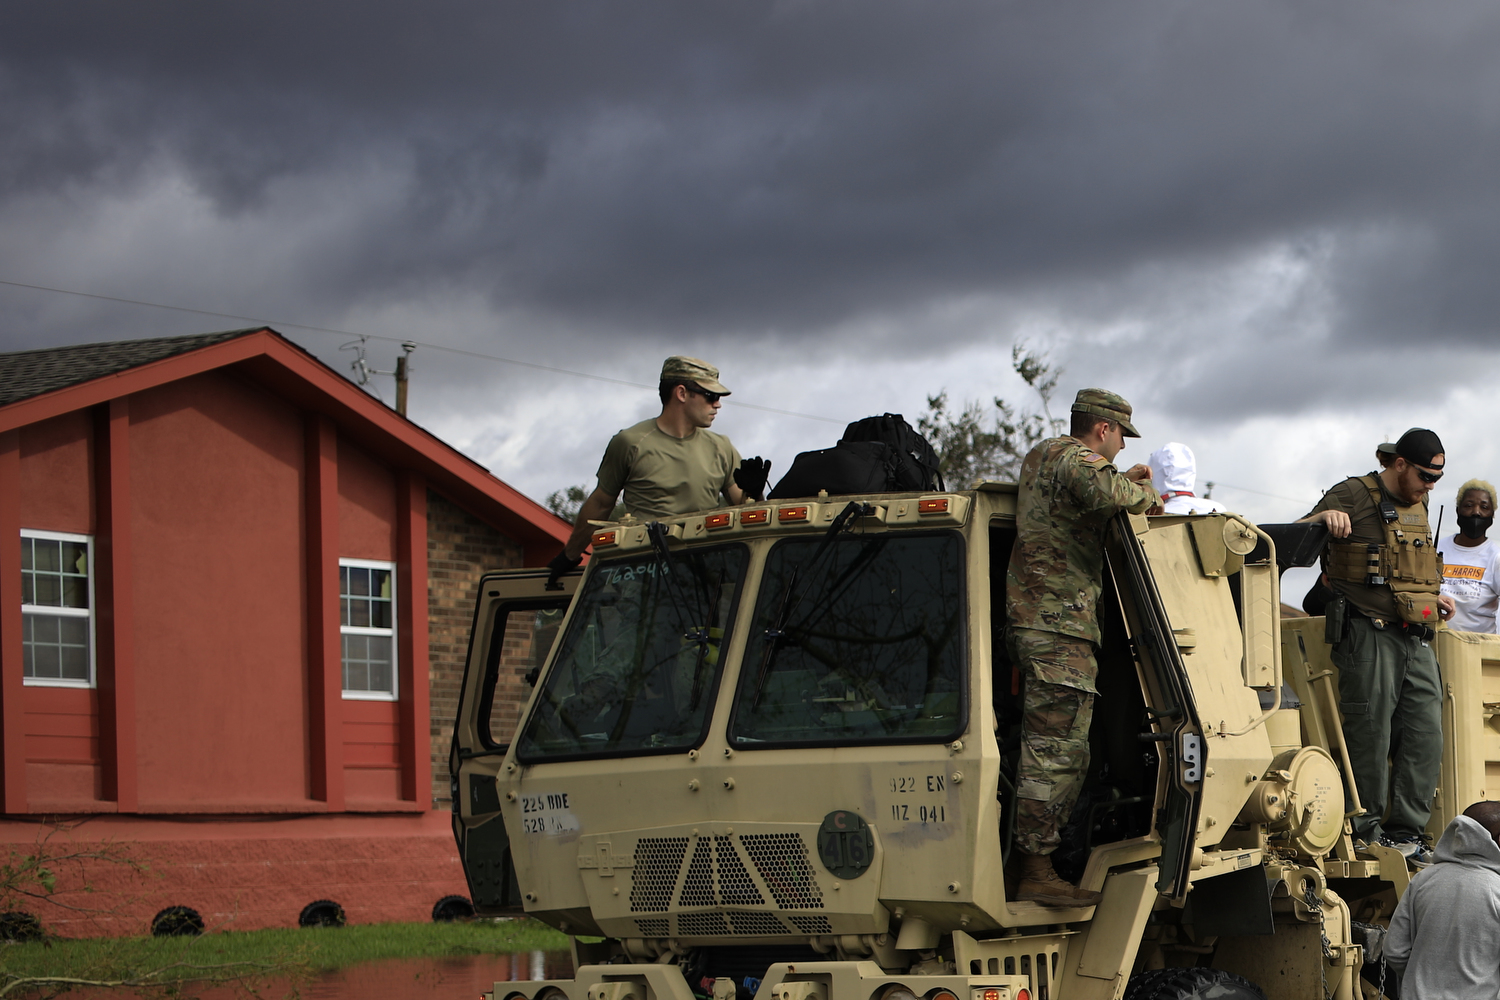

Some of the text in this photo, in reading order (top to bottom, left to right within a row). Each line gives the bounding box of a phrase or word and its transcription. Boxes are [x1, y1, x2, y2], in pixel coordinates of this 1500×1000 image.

[1452, 567, 1482, 578] HARRIS
[890, 775, 945, 793] 922 EN
[522, 793, 569, 813] 225 BDE
[834, 812, 847, 829] C
[920, 805, 945, 823] 041
[523, 817, 545, 833] 528
[824, 834, 865, 863] 46
